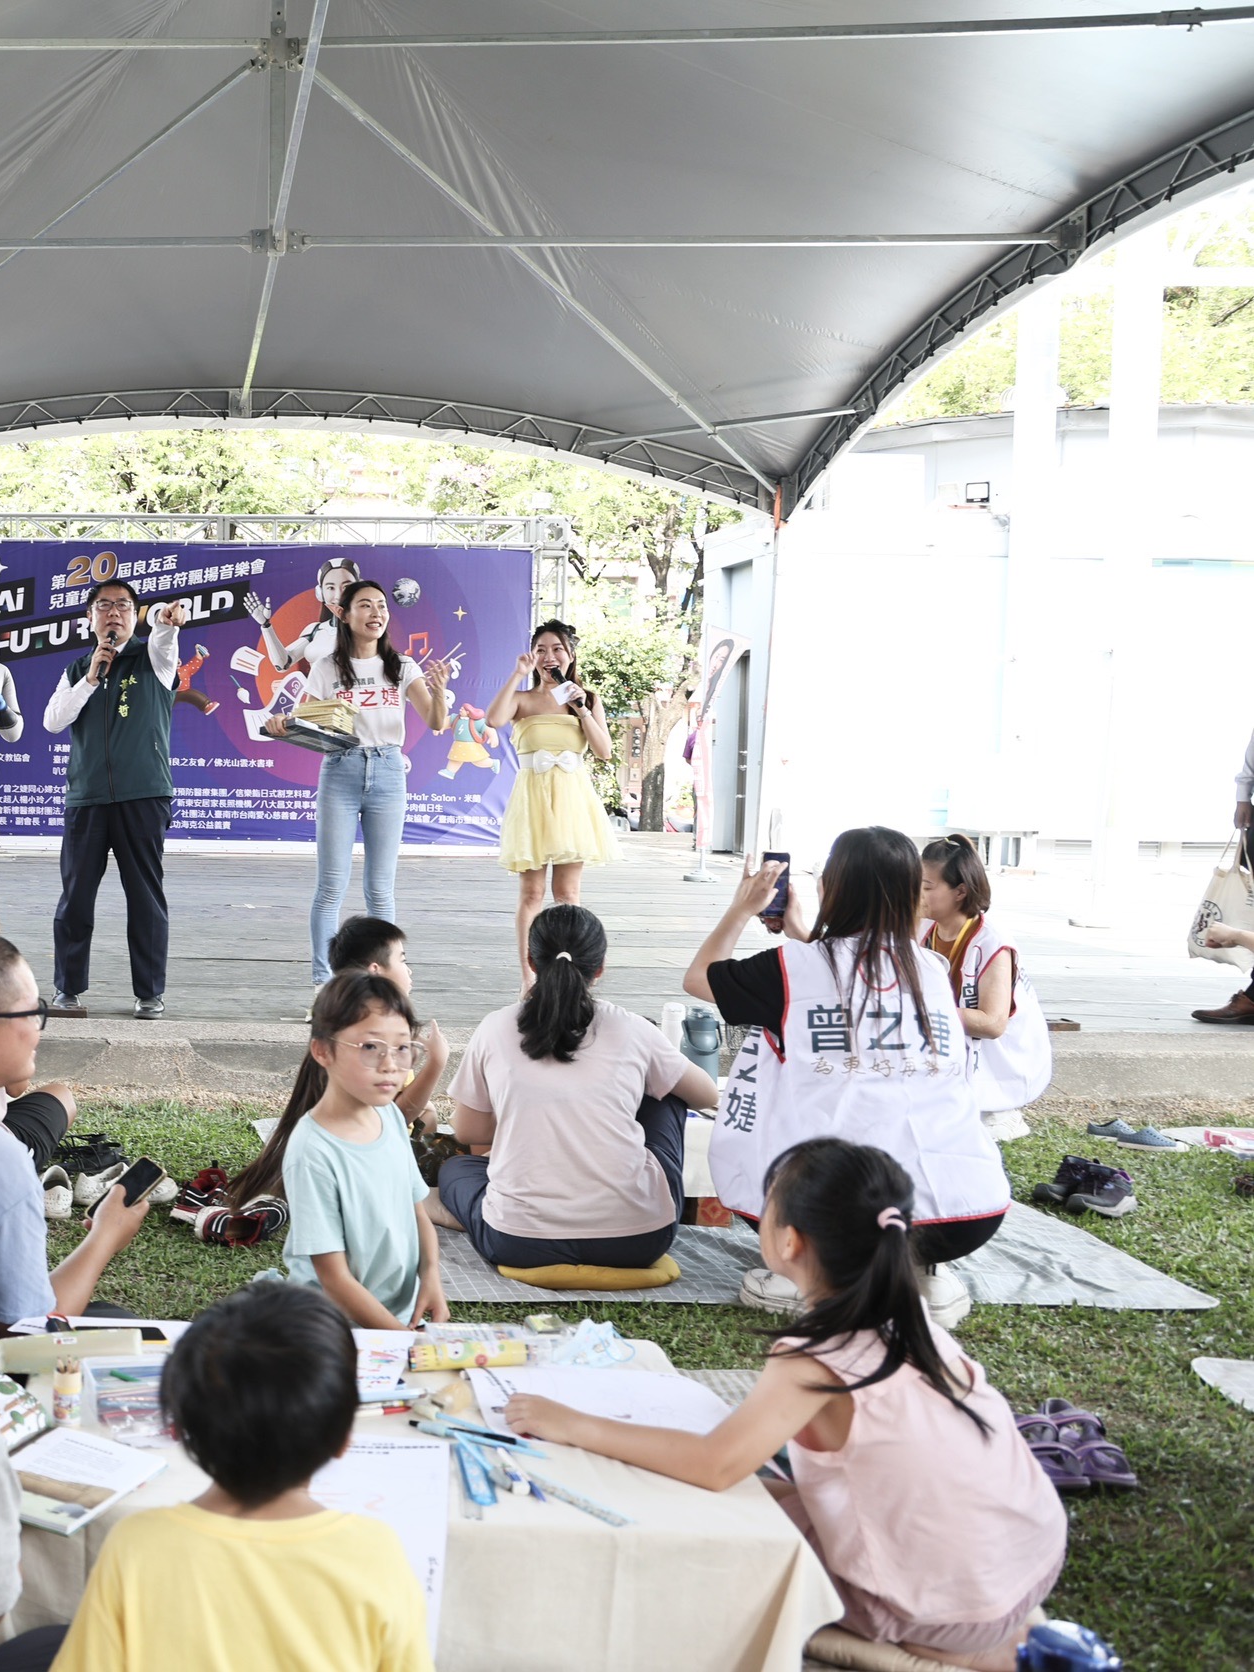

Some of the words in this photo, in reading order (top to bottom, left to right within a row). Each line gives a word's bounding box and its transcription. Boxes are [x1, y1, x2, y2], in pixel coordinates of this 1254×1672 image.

[51, 551, 178, 592] 第20屆良友盃
[336, 686, 400, 707] 曾之婕
[807, 1003, 952, 1058] 曾之婕
